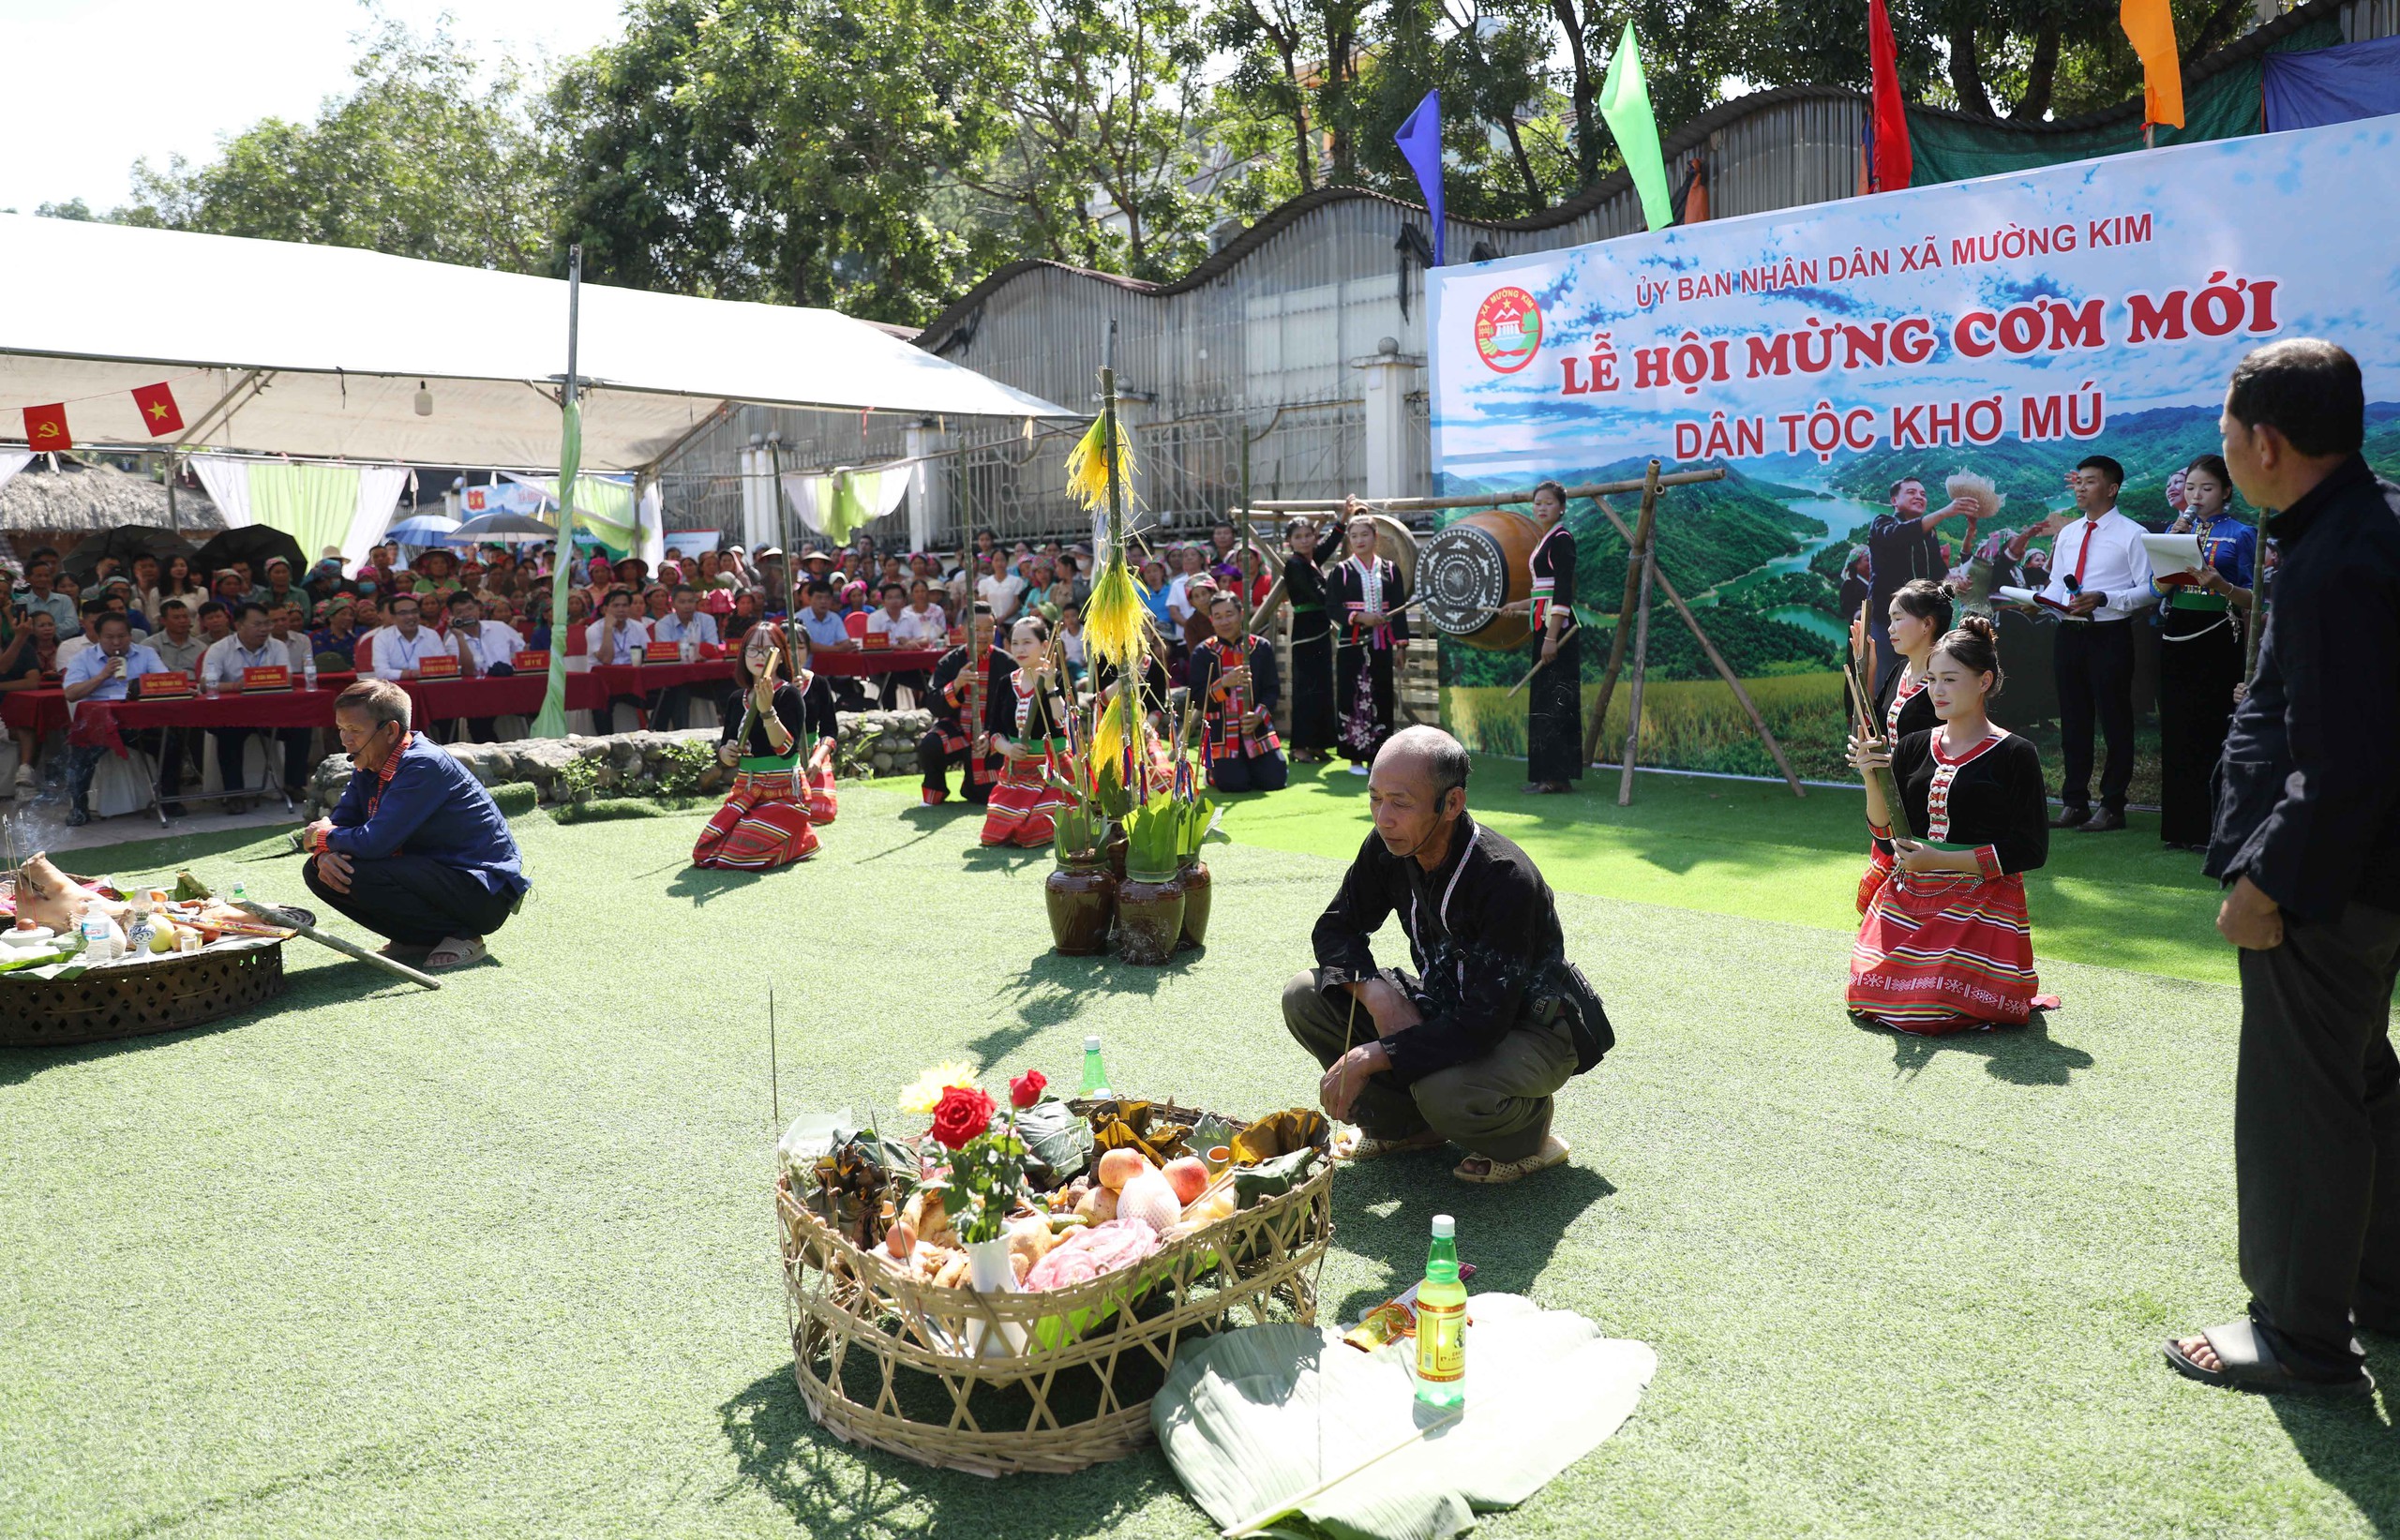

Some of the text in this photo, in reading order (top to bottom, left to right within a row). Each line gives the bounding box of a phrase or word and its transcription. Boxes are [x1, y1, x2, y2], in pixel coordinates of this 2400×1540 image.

[1490, 288, 1519, 304] MƯỜNG
[1521, 294, 1534, 309] KIM
[1636, 214, 2152, 307] ỦY BAN NHÂN DÂN XÃ MƯỜNG KIM
[1561, 271, 2278, 396] LỄ HỘI MỪNG CƠM MỚI
[1675, 381, 2103, 462] DÂN TỘC KHƠ MÚ
